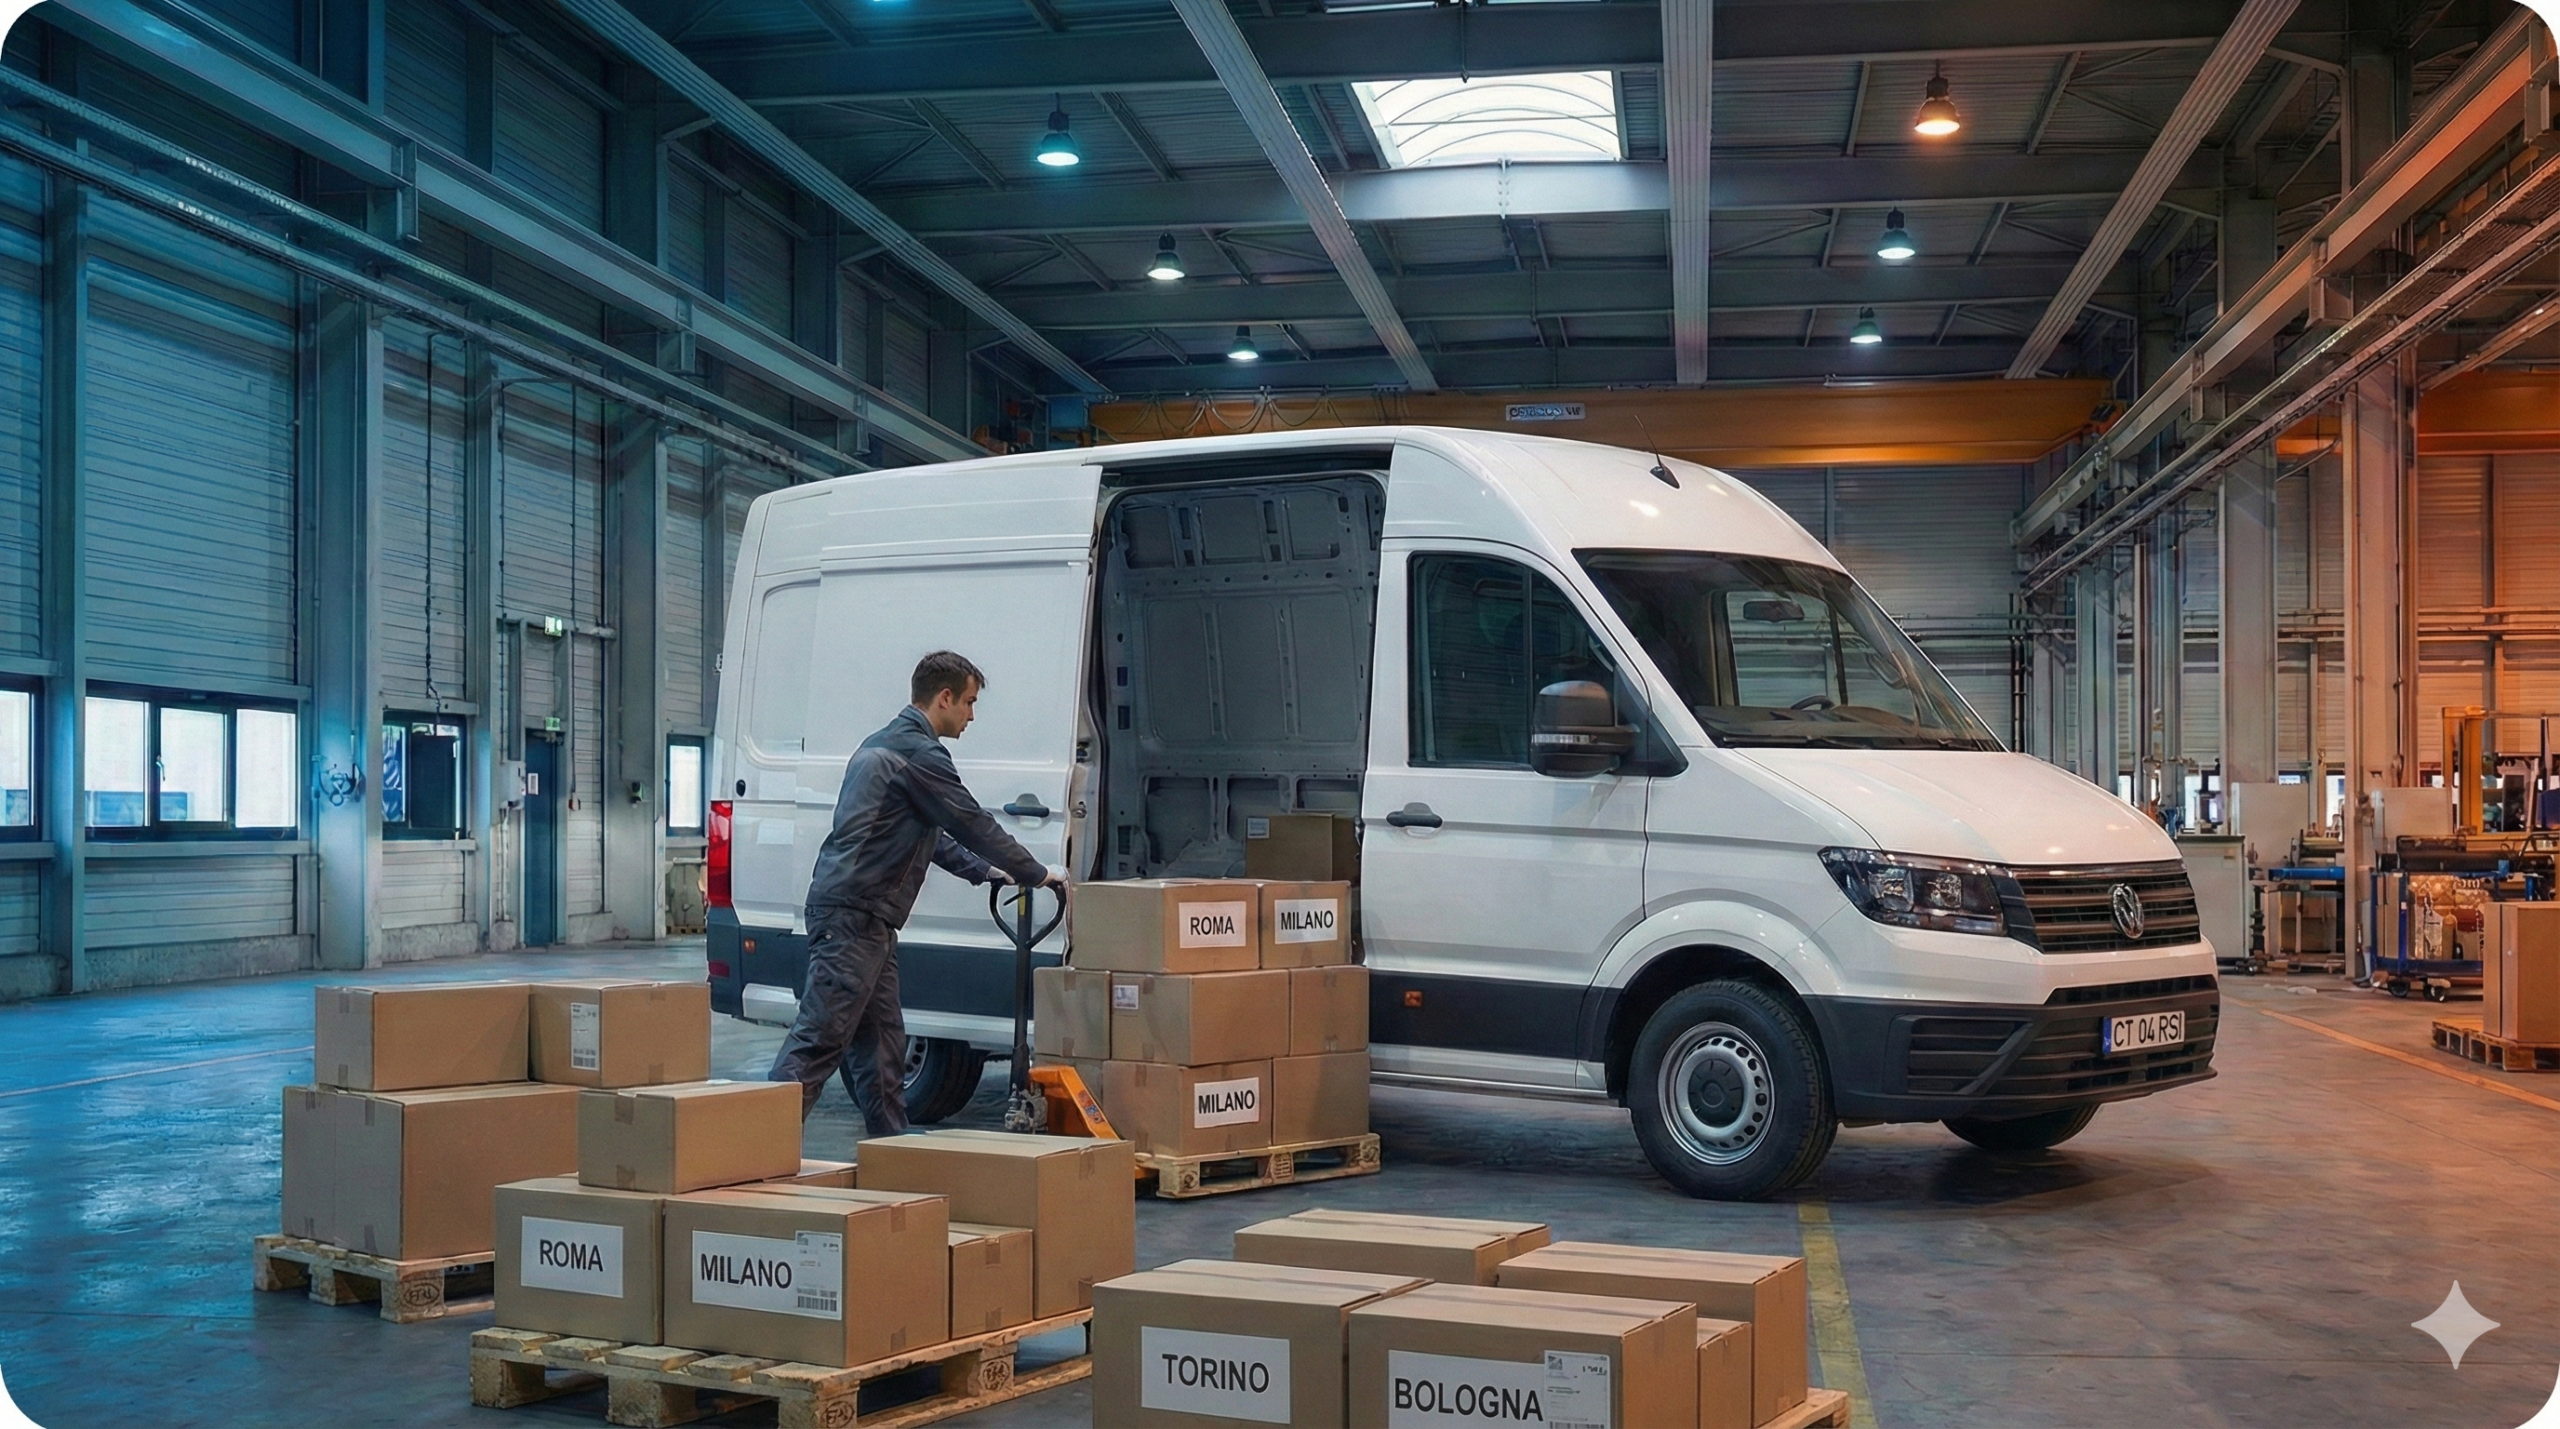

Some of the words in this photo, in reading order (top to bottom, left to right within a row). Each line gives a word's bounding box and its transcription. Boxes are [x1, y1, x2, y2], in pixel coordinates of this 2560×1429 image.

[1190, 915, 1235, 936] ROMA
[1281, 910, 1334, 930] MILANO
[2114, 1019, 2134, 1047] CT
[2138, 1016, 2155, 1044] 04
[2158, 1013, 2182, 1043] RSI
[1198, 1089, 1255, 1114] MILANO
[540, 1239, 604, 1272] ROMA
[701, 1253, 792, 1289] MILANO
[1162, 1353, 1269, 1394] TORINO
[1394, 1377, 1544, 1422] BOLOGNA
